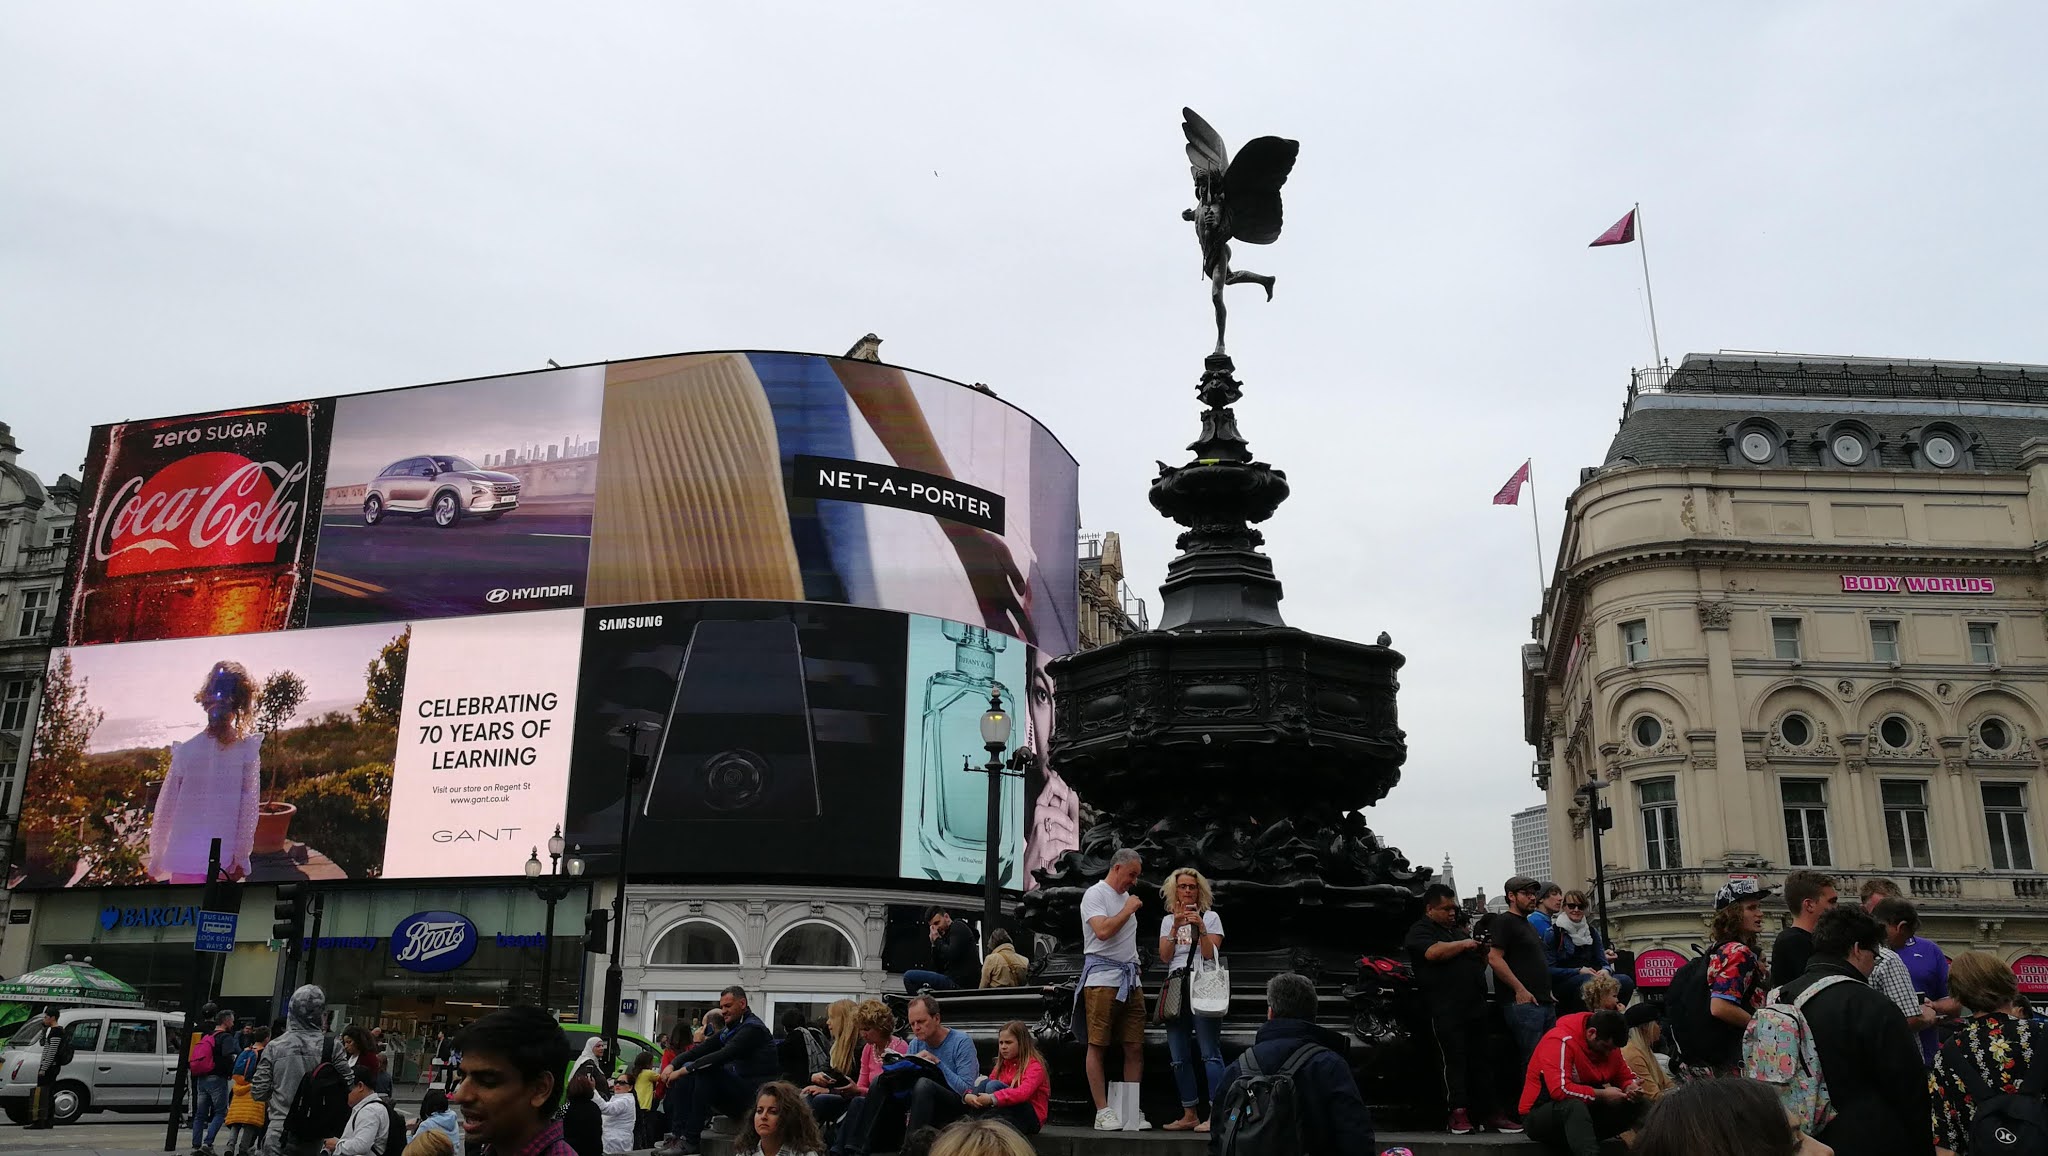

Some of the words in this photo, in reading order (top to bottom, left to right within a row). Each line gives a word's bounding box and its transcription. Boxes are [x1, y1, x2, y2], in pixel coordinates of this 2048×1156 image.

[153, 428, 201, 448] zero
[206, 422, 268, 441] SUGAR
[819, 469, 991, 519] NET-A-PORTER
[95, 461, 308, 561] Coca-Cola
[512, 584, 574, 600] HYUNDAI
[1844, 576, 1900, 591] BODY
[1906, 577, 1994, 592] WORLDS
[599, 615, 663, 631] SAMSUNG
[418, 692, 558, 718] CELEBRATING
[419, 725, 443, 744] 70
[450, 721, 514, 742] YEARS
[521, 719, 551, 739] OF
[432, 747, 537, 770] LEARNING
[432, 785, 448, 794] Visit
[463, 785, 482, 793] store
[494, 782, 521, 793] Regent
[522, 782, 531, 790] St
[450, 795, 510, 805] www.gant.co.uk
[432, 828, 521, 843] GANT
[396, 920, 466, 962] Boots
[1644, 958, 1676, 968] BODY
[1638, 967, 1679, 978] WORLD
